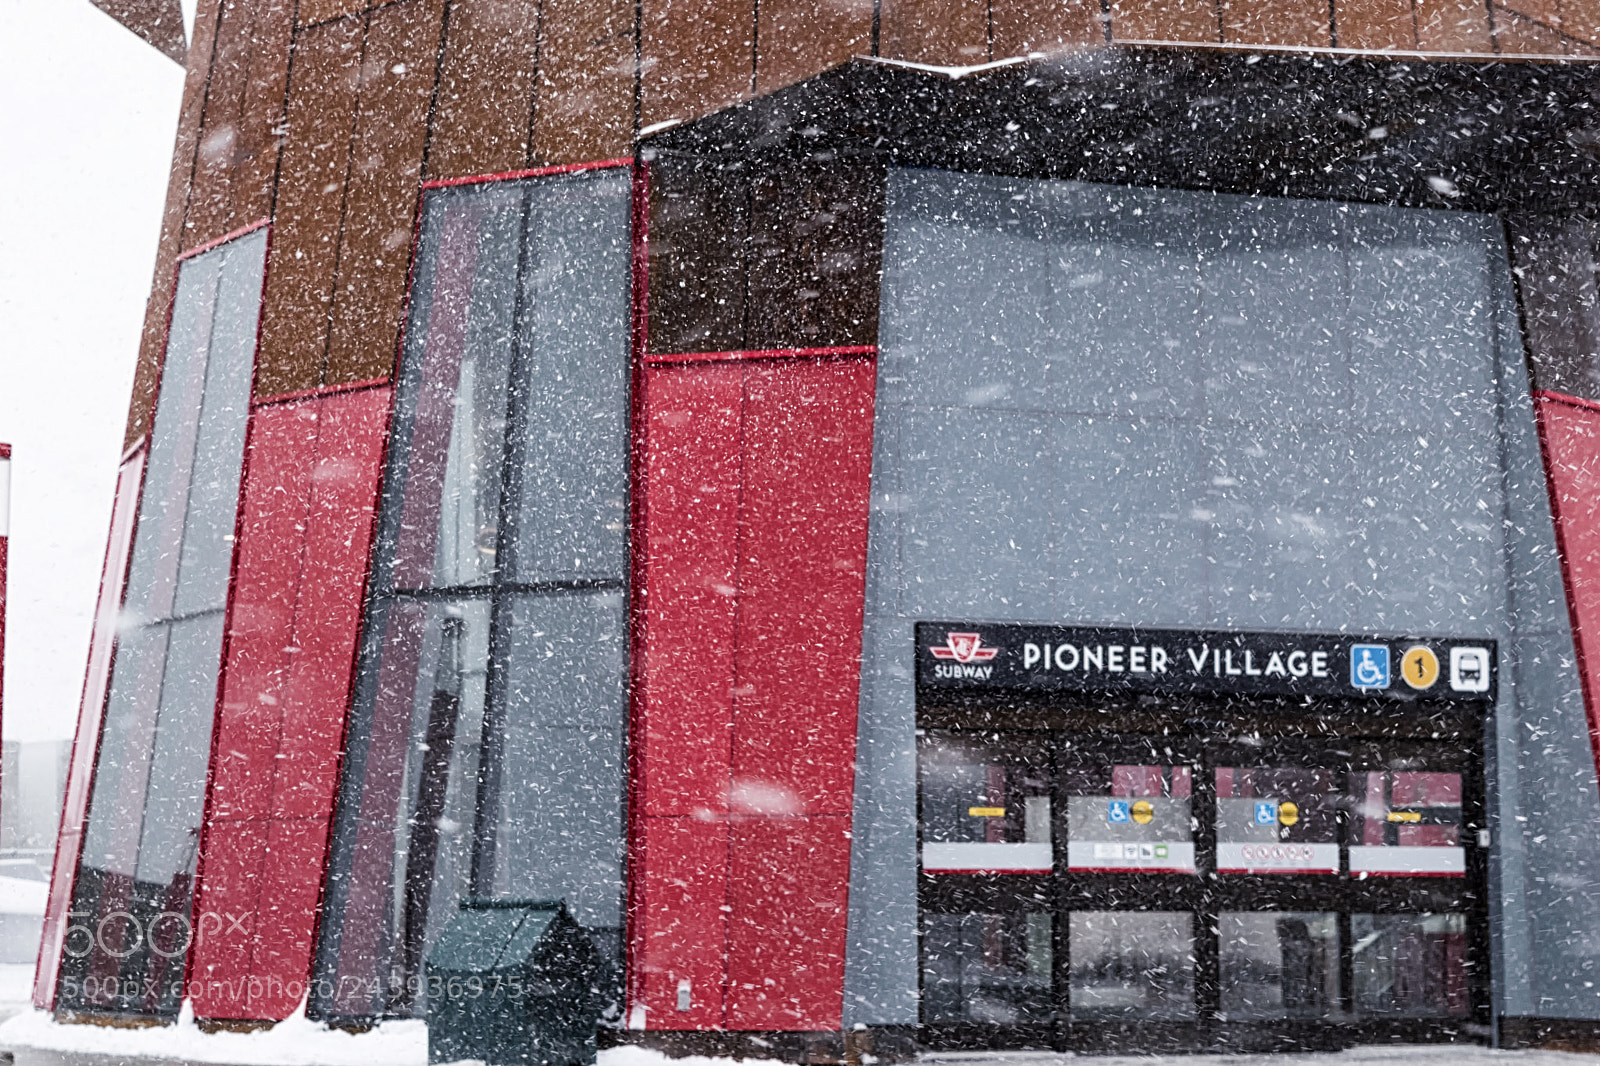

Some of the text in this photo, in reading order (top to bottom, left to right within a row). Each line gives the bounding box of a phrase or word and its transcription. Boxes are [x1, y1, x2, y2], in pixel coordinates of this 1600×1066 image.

[1023, 643, 1329, 678] PIONEER VILLAGE
[1414, 656, 1424, 678] 1
[934, 664, 993, 680] SUBWAY
